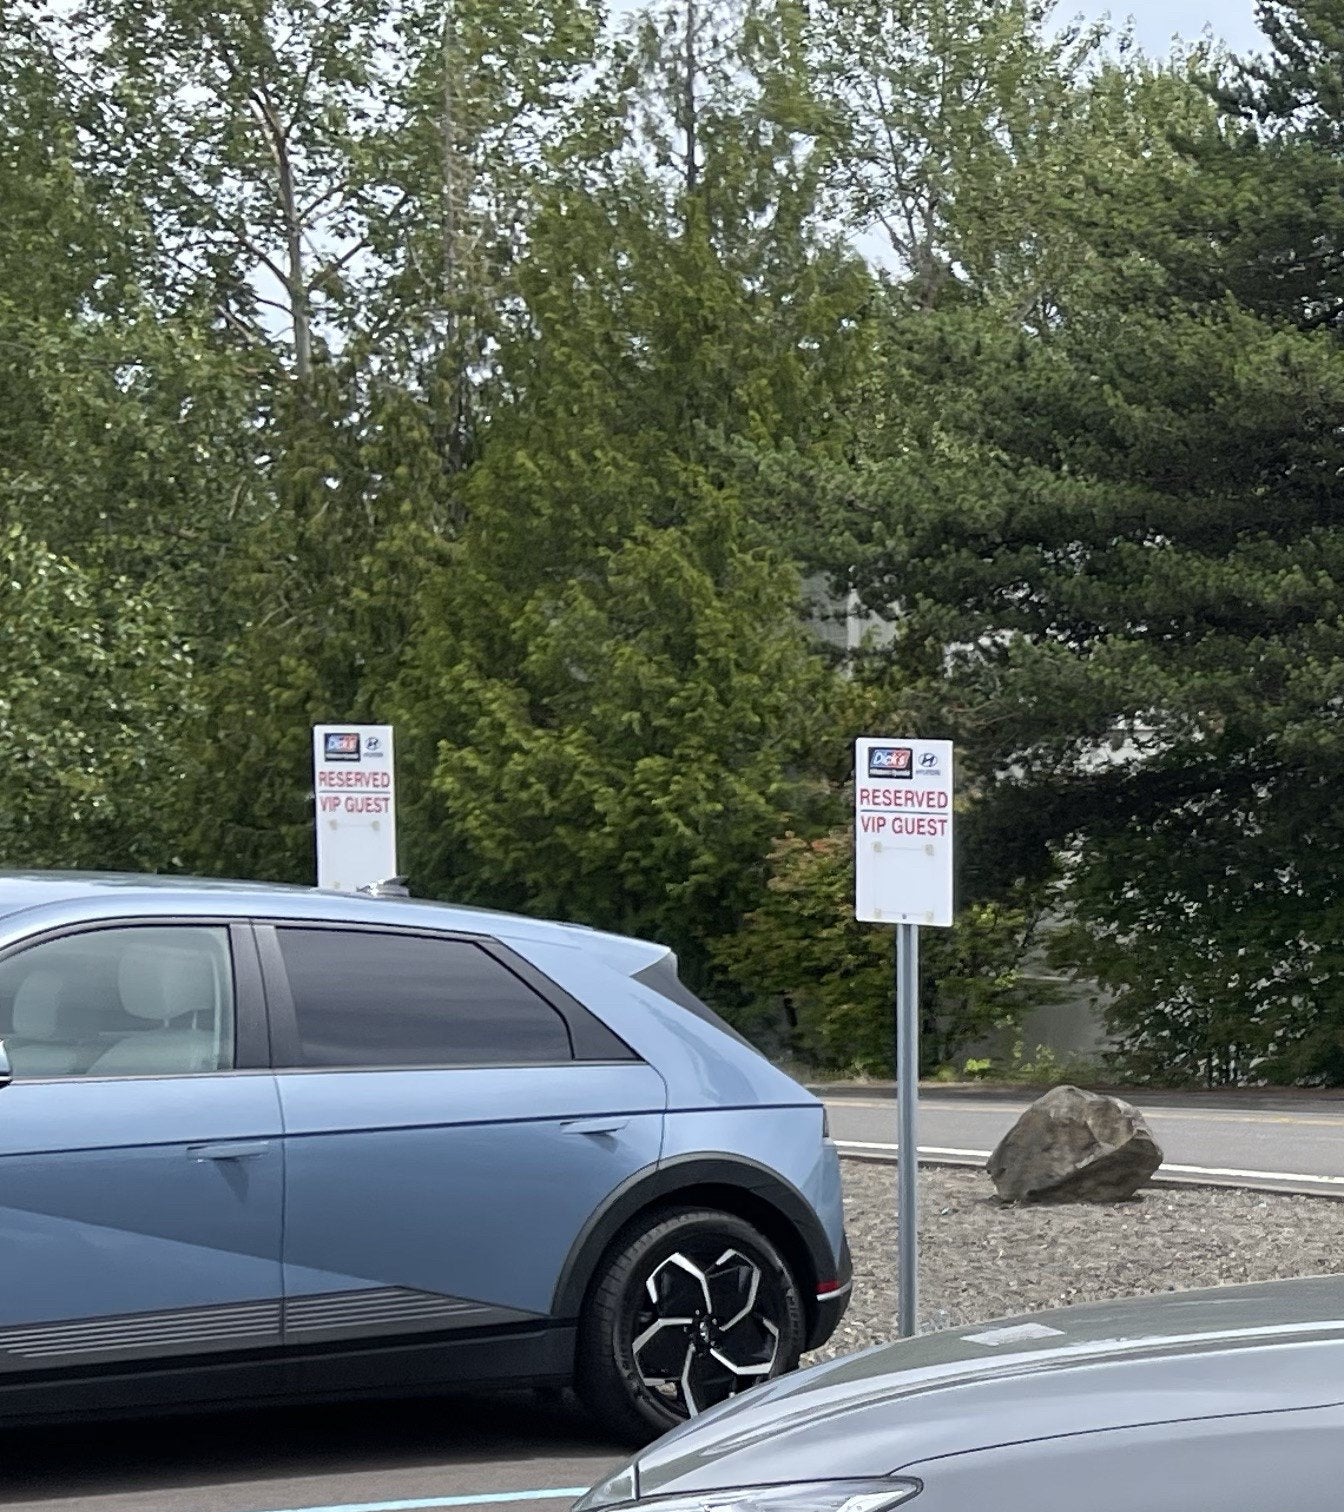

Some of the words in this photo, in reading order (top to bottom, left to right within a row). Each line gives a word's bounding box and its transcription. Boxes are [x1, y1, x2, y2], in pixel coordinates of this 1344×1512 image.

[319, 771, 390, 787] RESERVED
[320, 797, 341, 812] VIP
[345, 798, 390, 813] GUEST
[859, 788, 948, 809] RESERVED
[861, 816, 887, 833] VIP
[892, 816, 948, 836] GUEST
